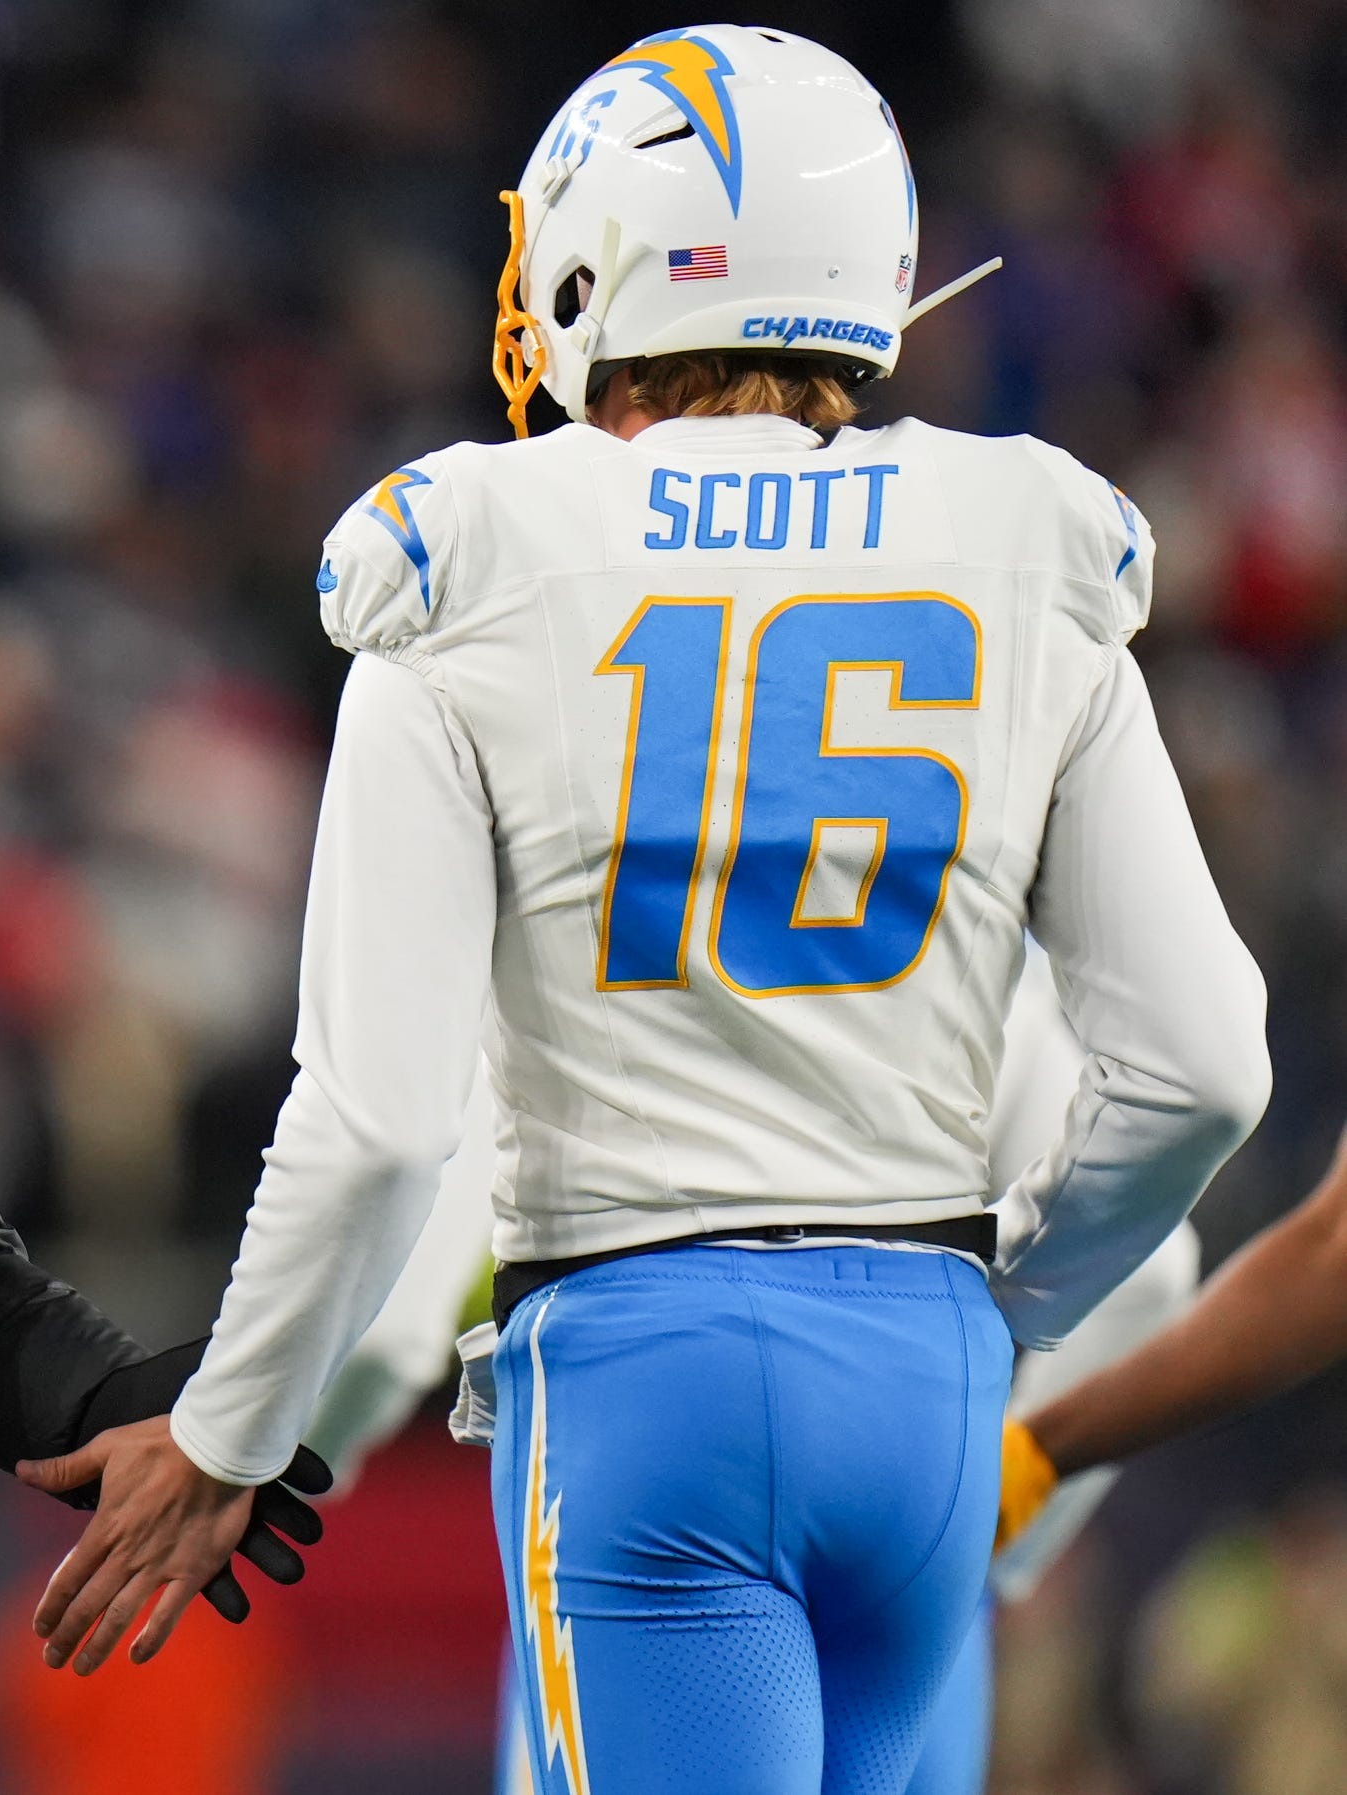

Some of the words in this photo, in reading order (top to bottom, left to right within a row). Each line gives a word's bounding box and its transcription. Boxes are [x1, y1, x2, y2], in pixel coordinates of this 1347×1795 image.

[743, 317, 894, 350] CHARGERS
[644, 464, 899, 550] SCOTT
[593, 590, 983, 999] 16
